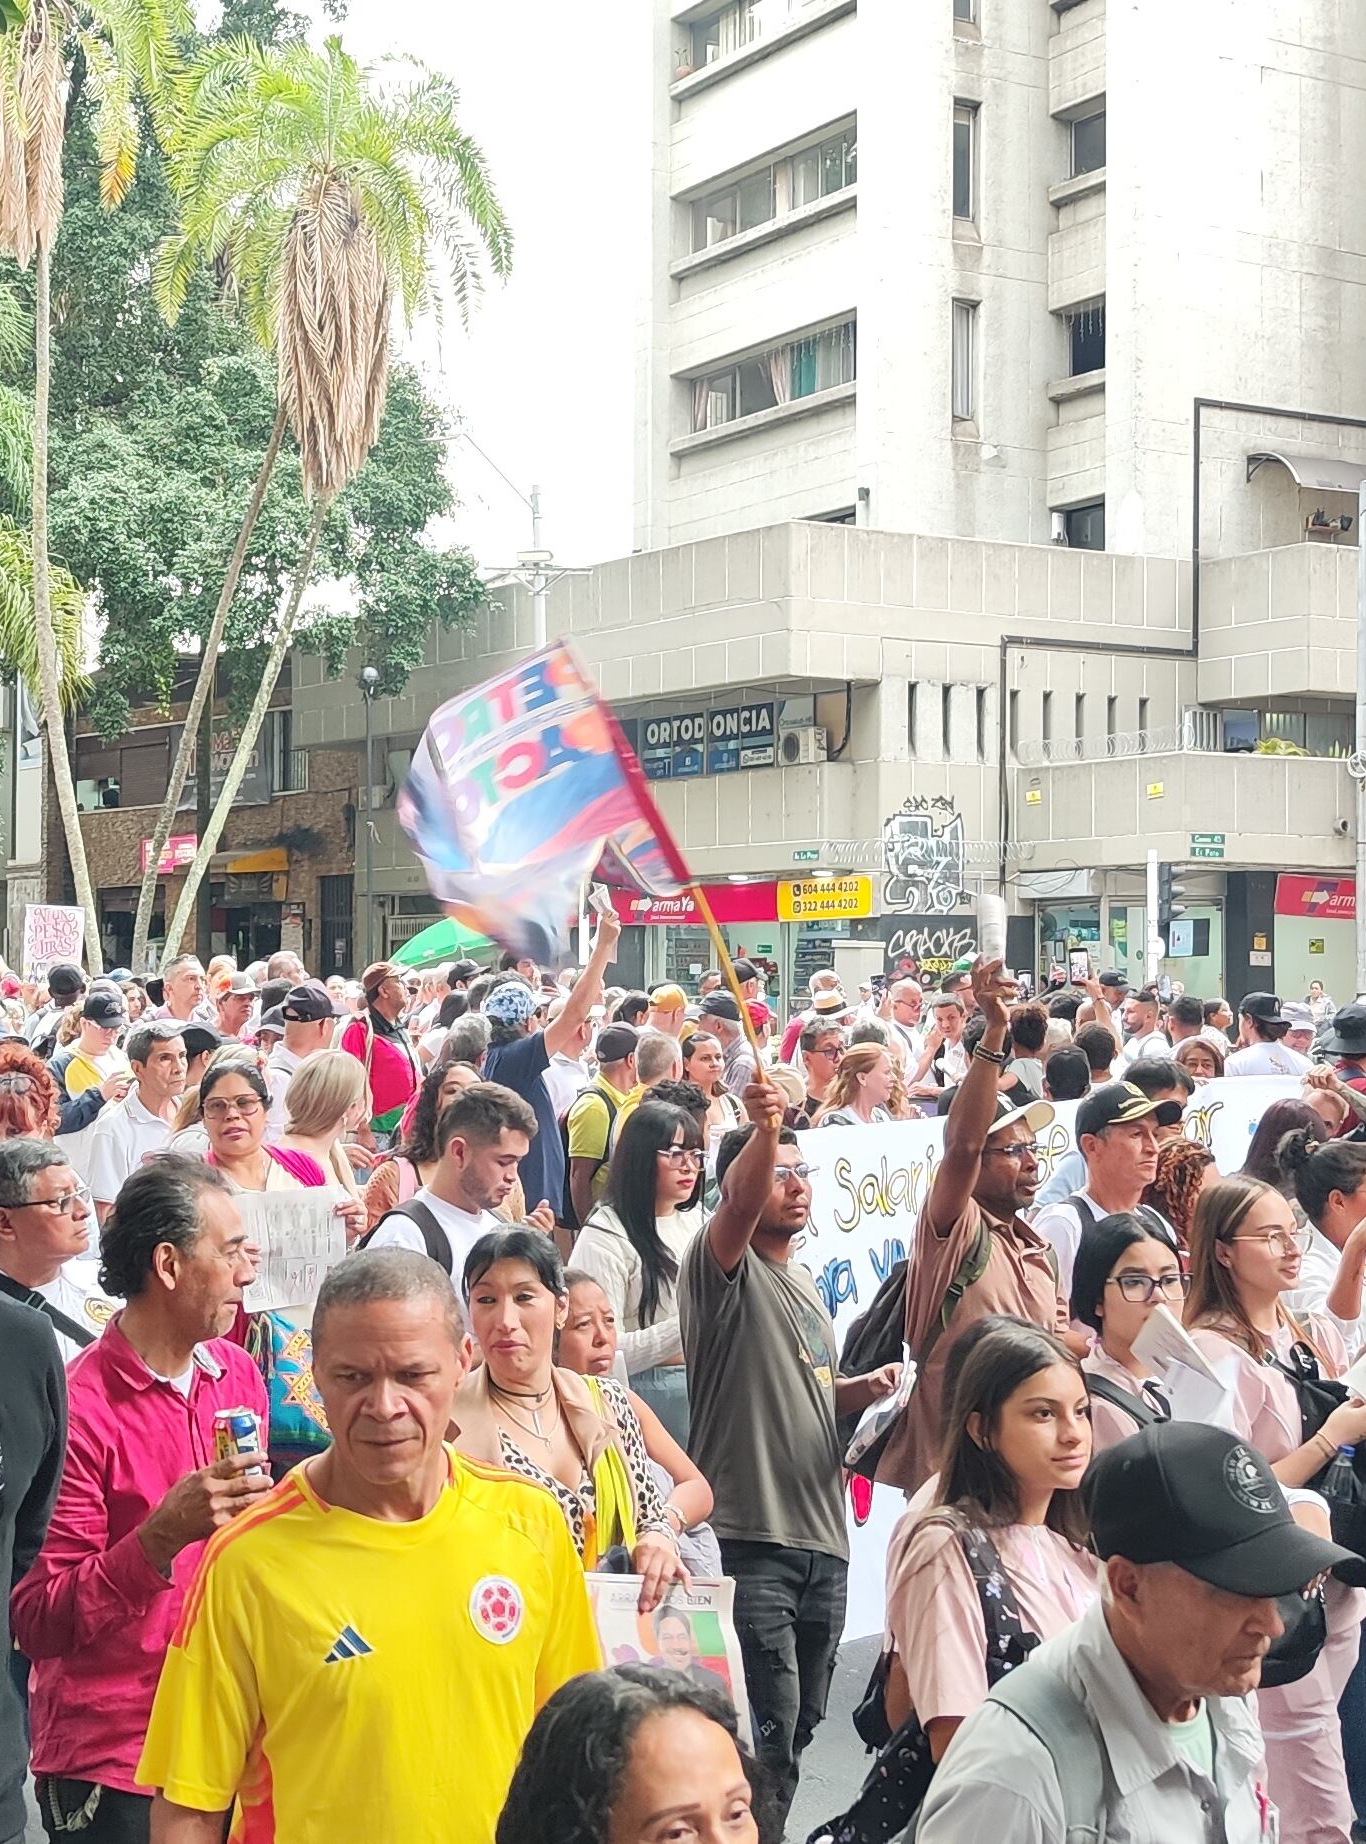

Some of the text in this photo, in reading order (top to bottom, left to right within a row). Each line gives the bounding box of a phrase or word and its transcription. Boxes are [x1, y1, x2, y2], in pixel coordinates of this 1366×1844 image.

[646, 707, 771, 744] ORTODONCIA
[802, 880, 859, 895] 604 444 4202
[802, 898, 859, 912] 322 444 4202
[835, 1144, 940, 1234] Salari
[687, 1596, 712, 1605] BIEN
